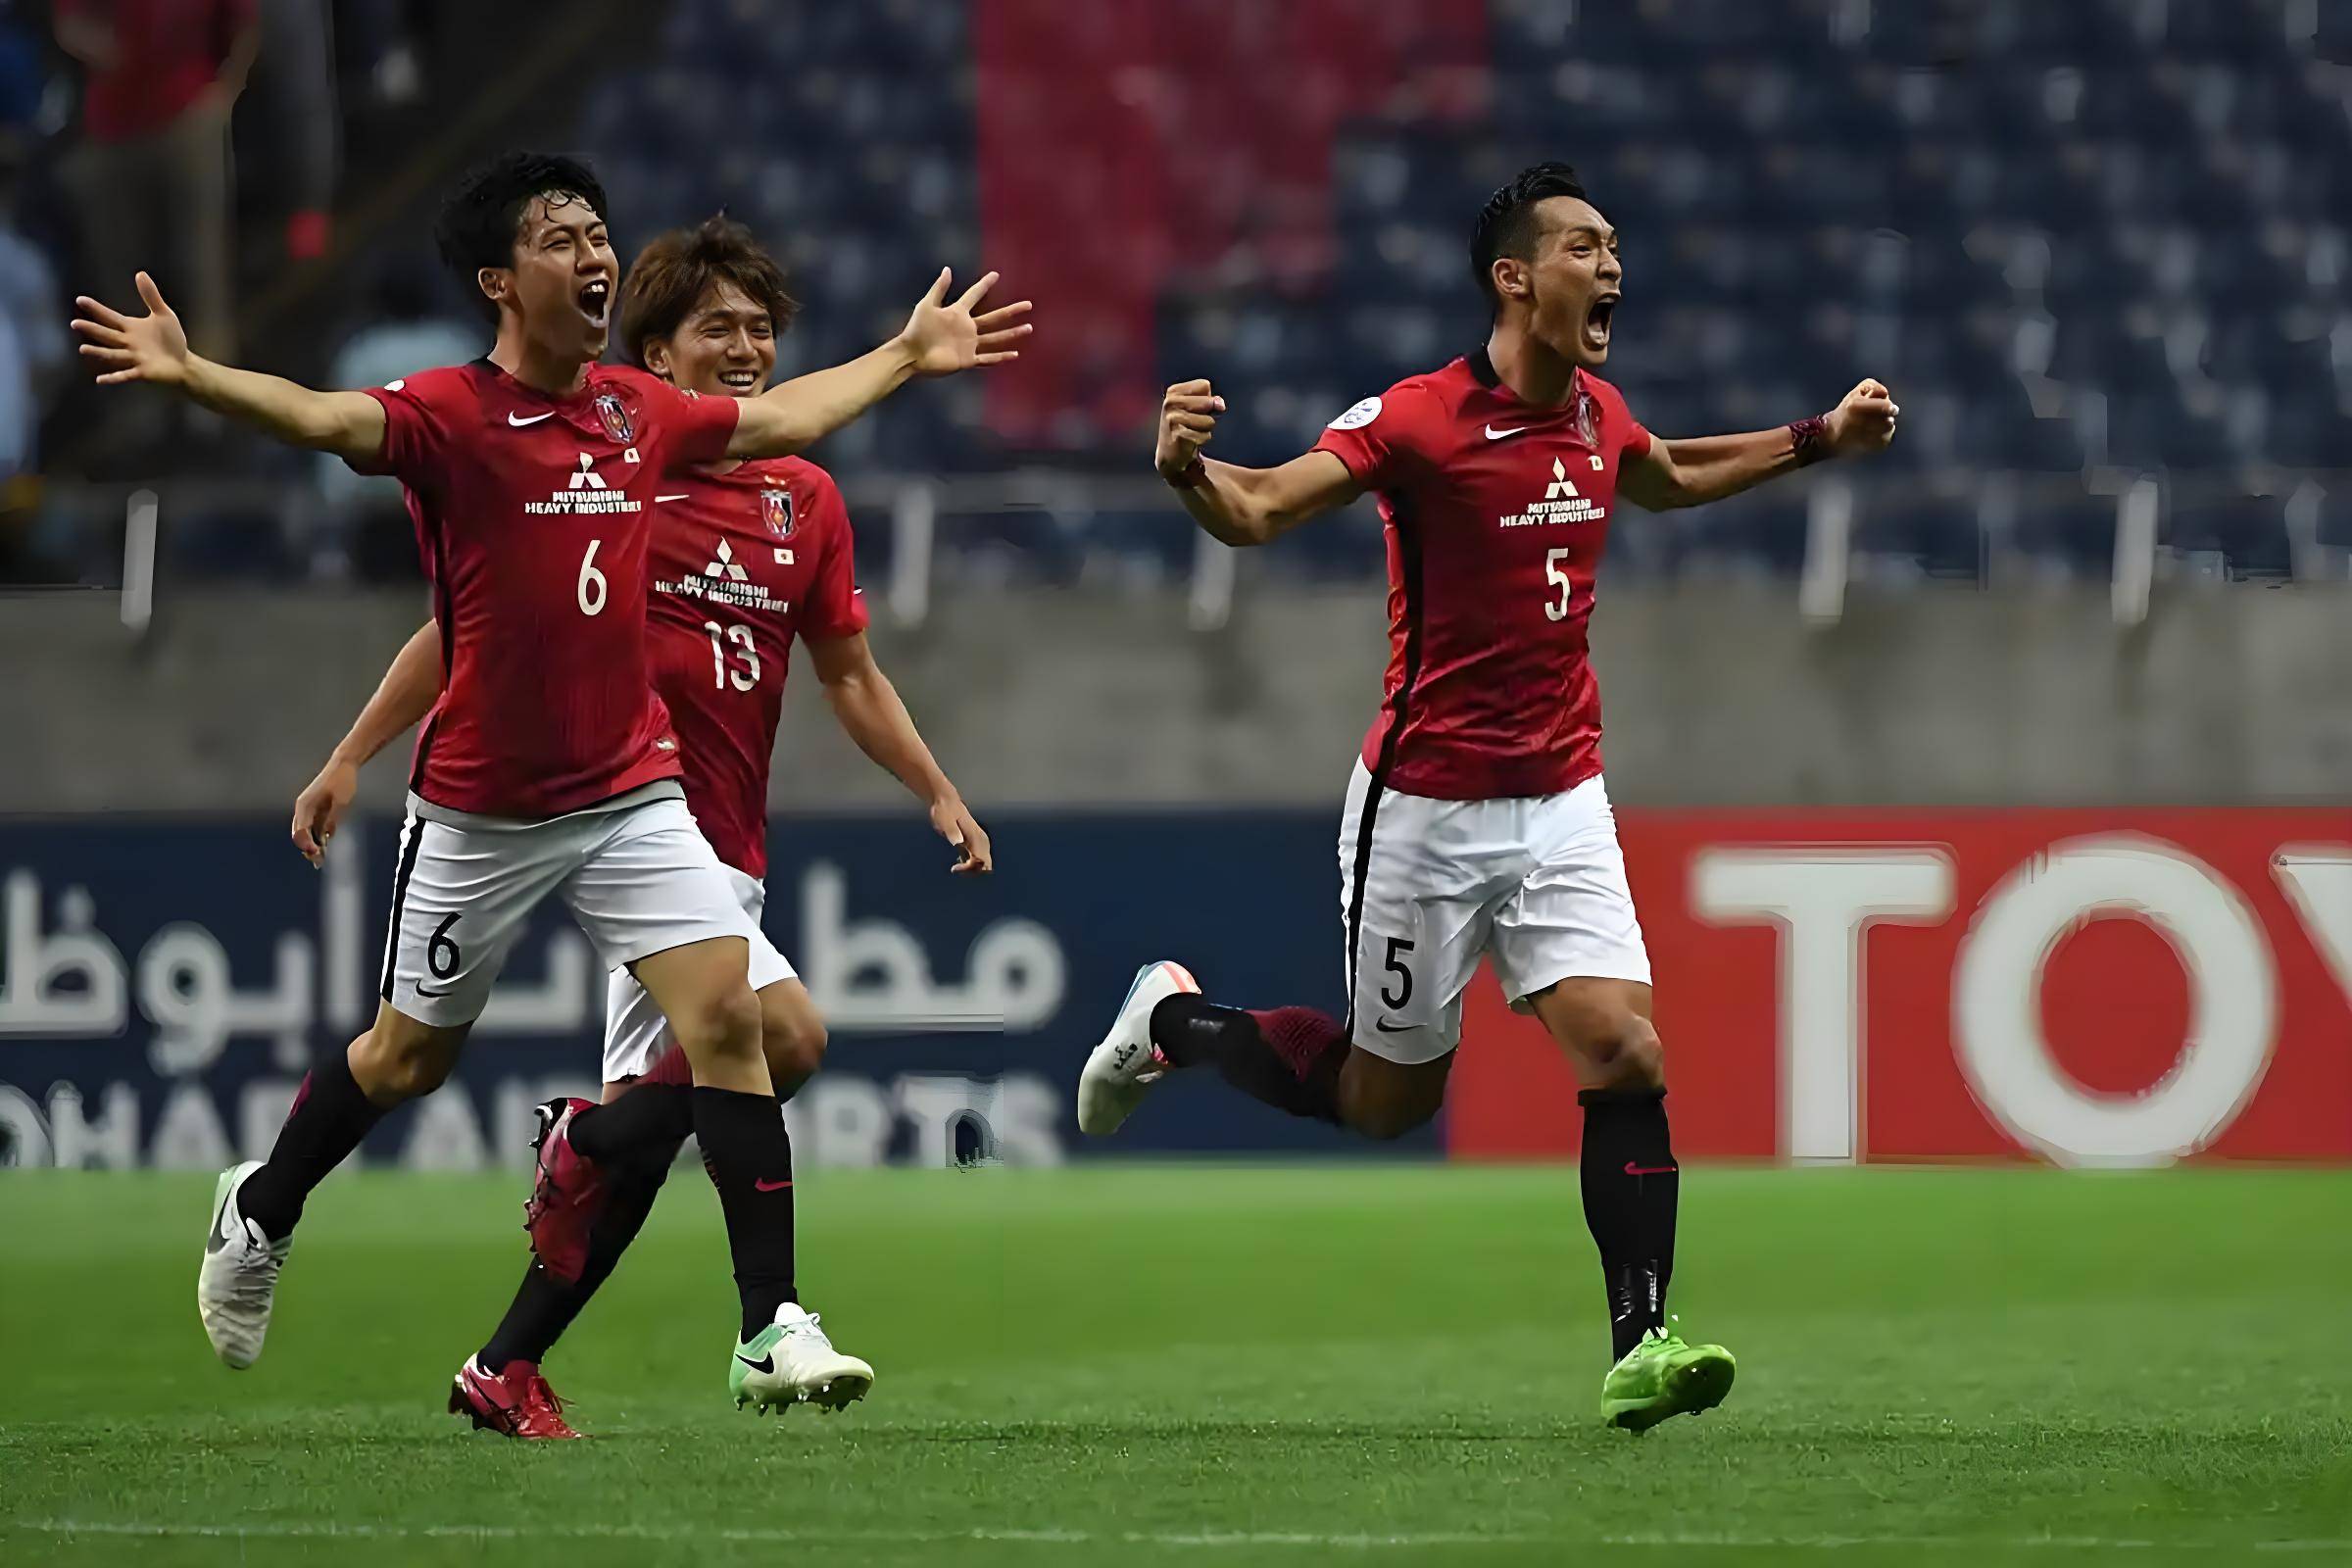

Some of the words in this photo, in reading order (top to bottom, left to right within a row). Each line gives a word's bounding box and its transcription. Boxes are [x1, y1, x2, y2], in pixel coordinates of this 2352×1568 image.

[524, 502, 571, 514] HEAVY
[1499, 514, 1545, 527] HEAVY
[577, 539, 608, 615] 6
[1544, 548, 1571, 621] 5
[704, 620, 760, 692] 13
[427, 911, 463, 980] 6
[1381, 936, 1415, 1010] 5
[0, 1078, 367, 1171] DHA
